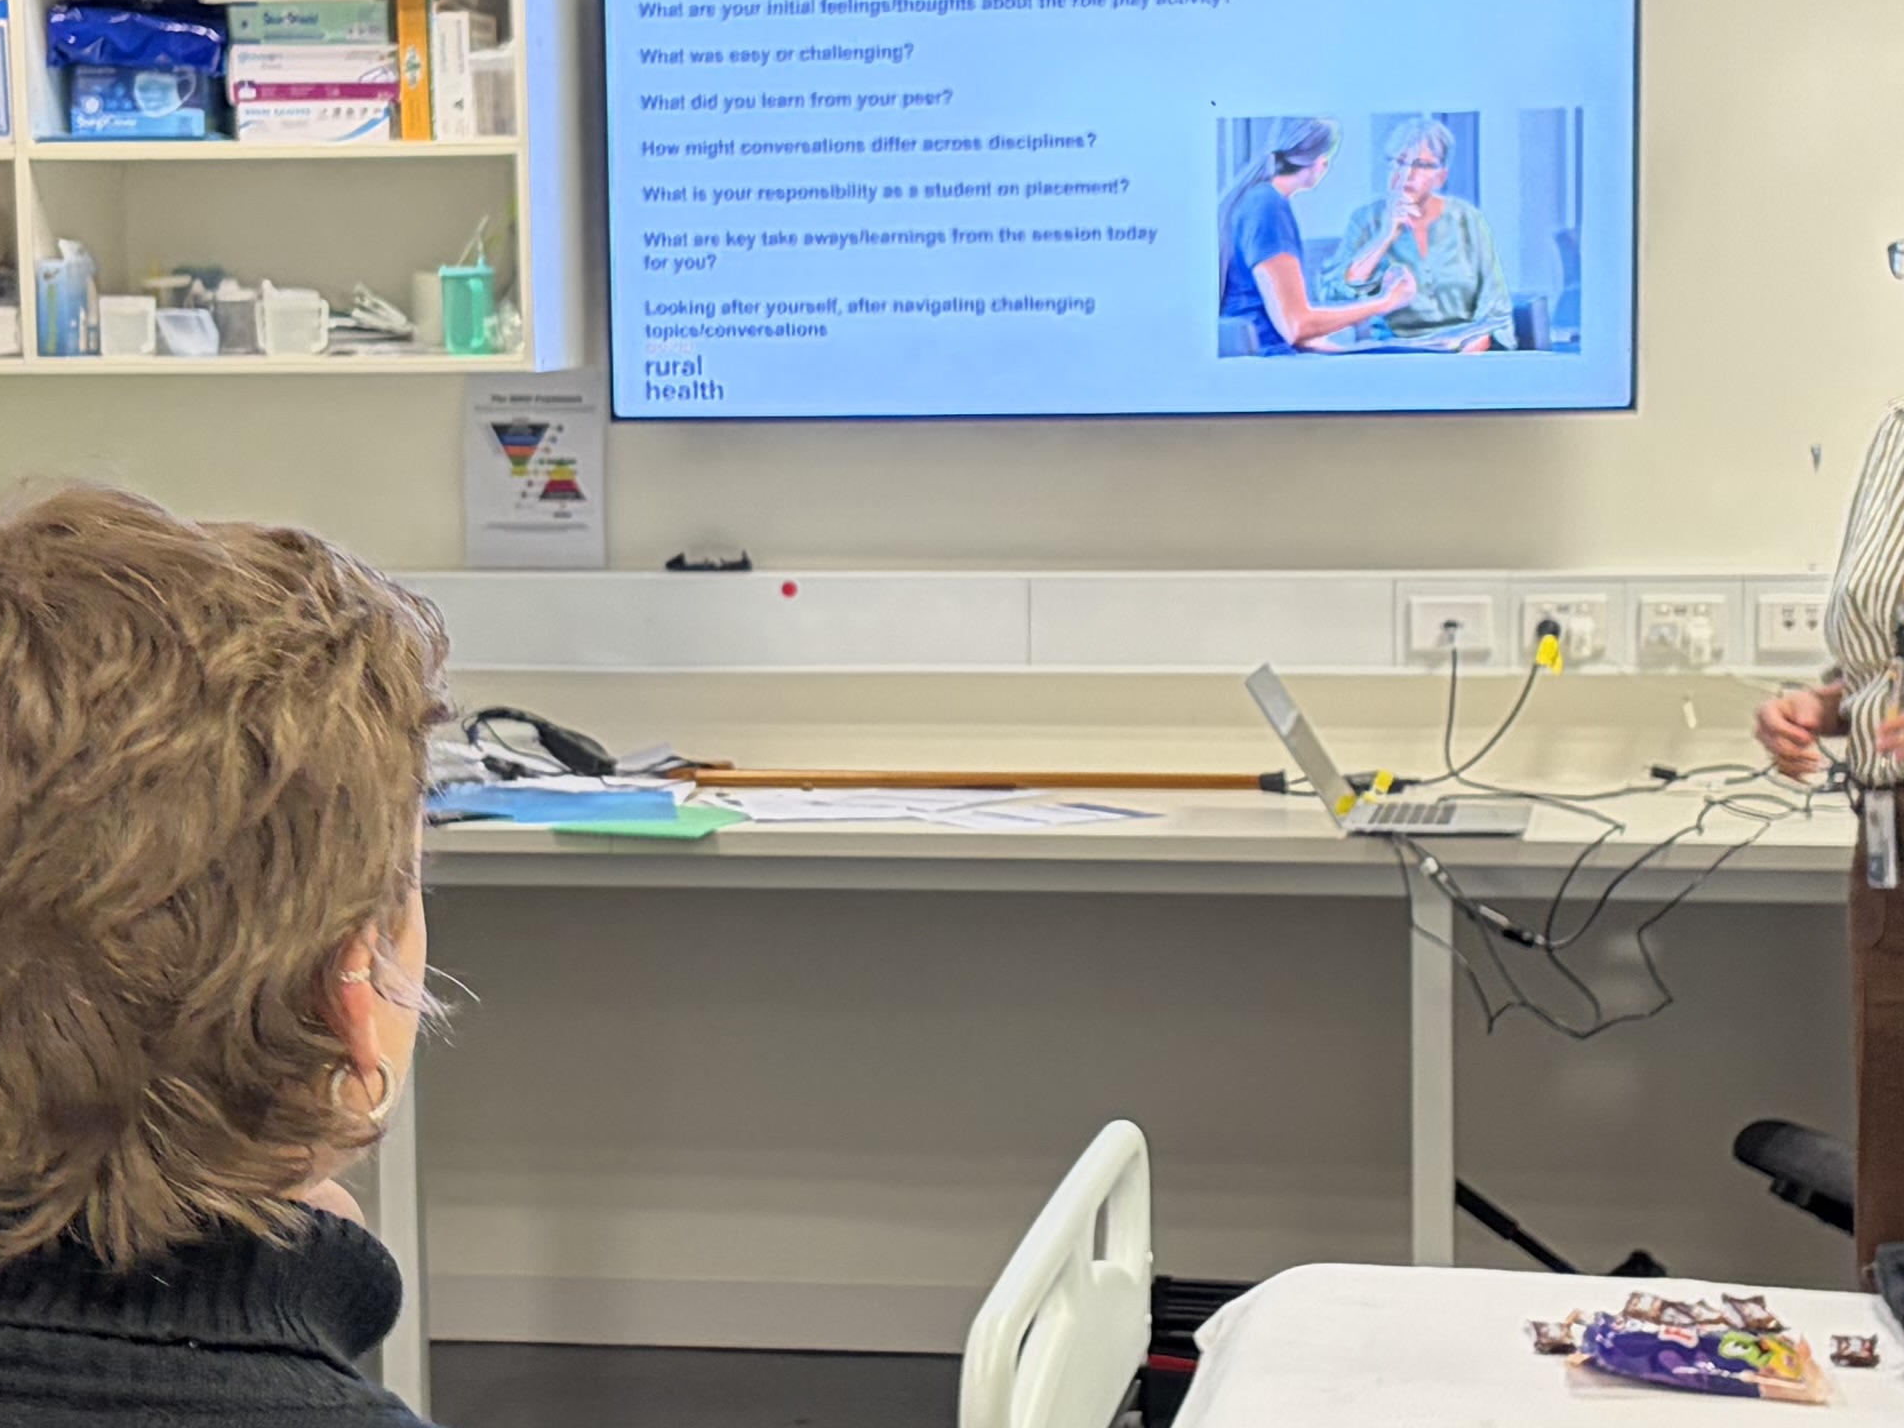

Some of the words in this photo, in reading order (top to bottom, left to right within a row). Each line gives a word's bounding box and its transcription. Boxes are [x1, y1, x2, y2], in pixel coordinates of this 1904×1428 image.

[638, 1, 684, 18] What
[688, 4, 715, 17] are
[722, 3, 761, 21] your
[639, 47, 684, 64] What
[690, 50, 724, 63] was
[729, 49, 771, 66] easy
[776, 49, 794, 62] or
[799, 43, 914, 64] challenging?
[640, 94, 686, 110] What
[691, 93, 718, 110] did
[723, 96, 756, 114] you
[762, 92, 805, 108] learn
[811, 91, 852, 108] from
[856, 93, 897, 111] your
[903, 88, 953, 110] peer?
[641, 140, 680, 157] How
[685, 138, 735, 159] might
[740, 137, 866, 155] conversations
[871, 136, 917, 153] differ
[922, 138, 982, 152] across
[988, 132, 1097, 153] disciplines?
[643, 186, 687, 202] What
[693, 186, 707, 202] is
[712, 187, 751, 206] your
[757, 183, 877, 204] responsibility
[883, 185, 903, 199] as
[909, 185, 918, 198] a
[924, 181, 991, 198] student
[997, 183, 1019, 197] on
[1026, 178, 1130, 200] placement?
[644, 232, 688, 248] What
[694, 234, 720, 247] are
[726, 232, 756, 250] key
[761, 230, 798, 247] take
[804, 228, 945, 250] aways/learnings
[951, 228, 993, 244] from
[999, 227, 1026, 244] the
[1032, 226, 1101, 242] session
[1107, 225, 1158, 245] today
[643, 254, 668, 271] for
[674, 253, 716, 274] you?
[645, 300, 716, 318] Looking
[721, 299, 761, 315] after
[765, 297, 842, 318] yourself,
[847, 297, 887, 314] after
[893, 296, 985, 317] navigating
[991, 295, 1096, 315] challenging
[645, 322, 828, 341] topics/conversations
[645, 354, 703, 377] rural
[645, 380, 724, 400] health
